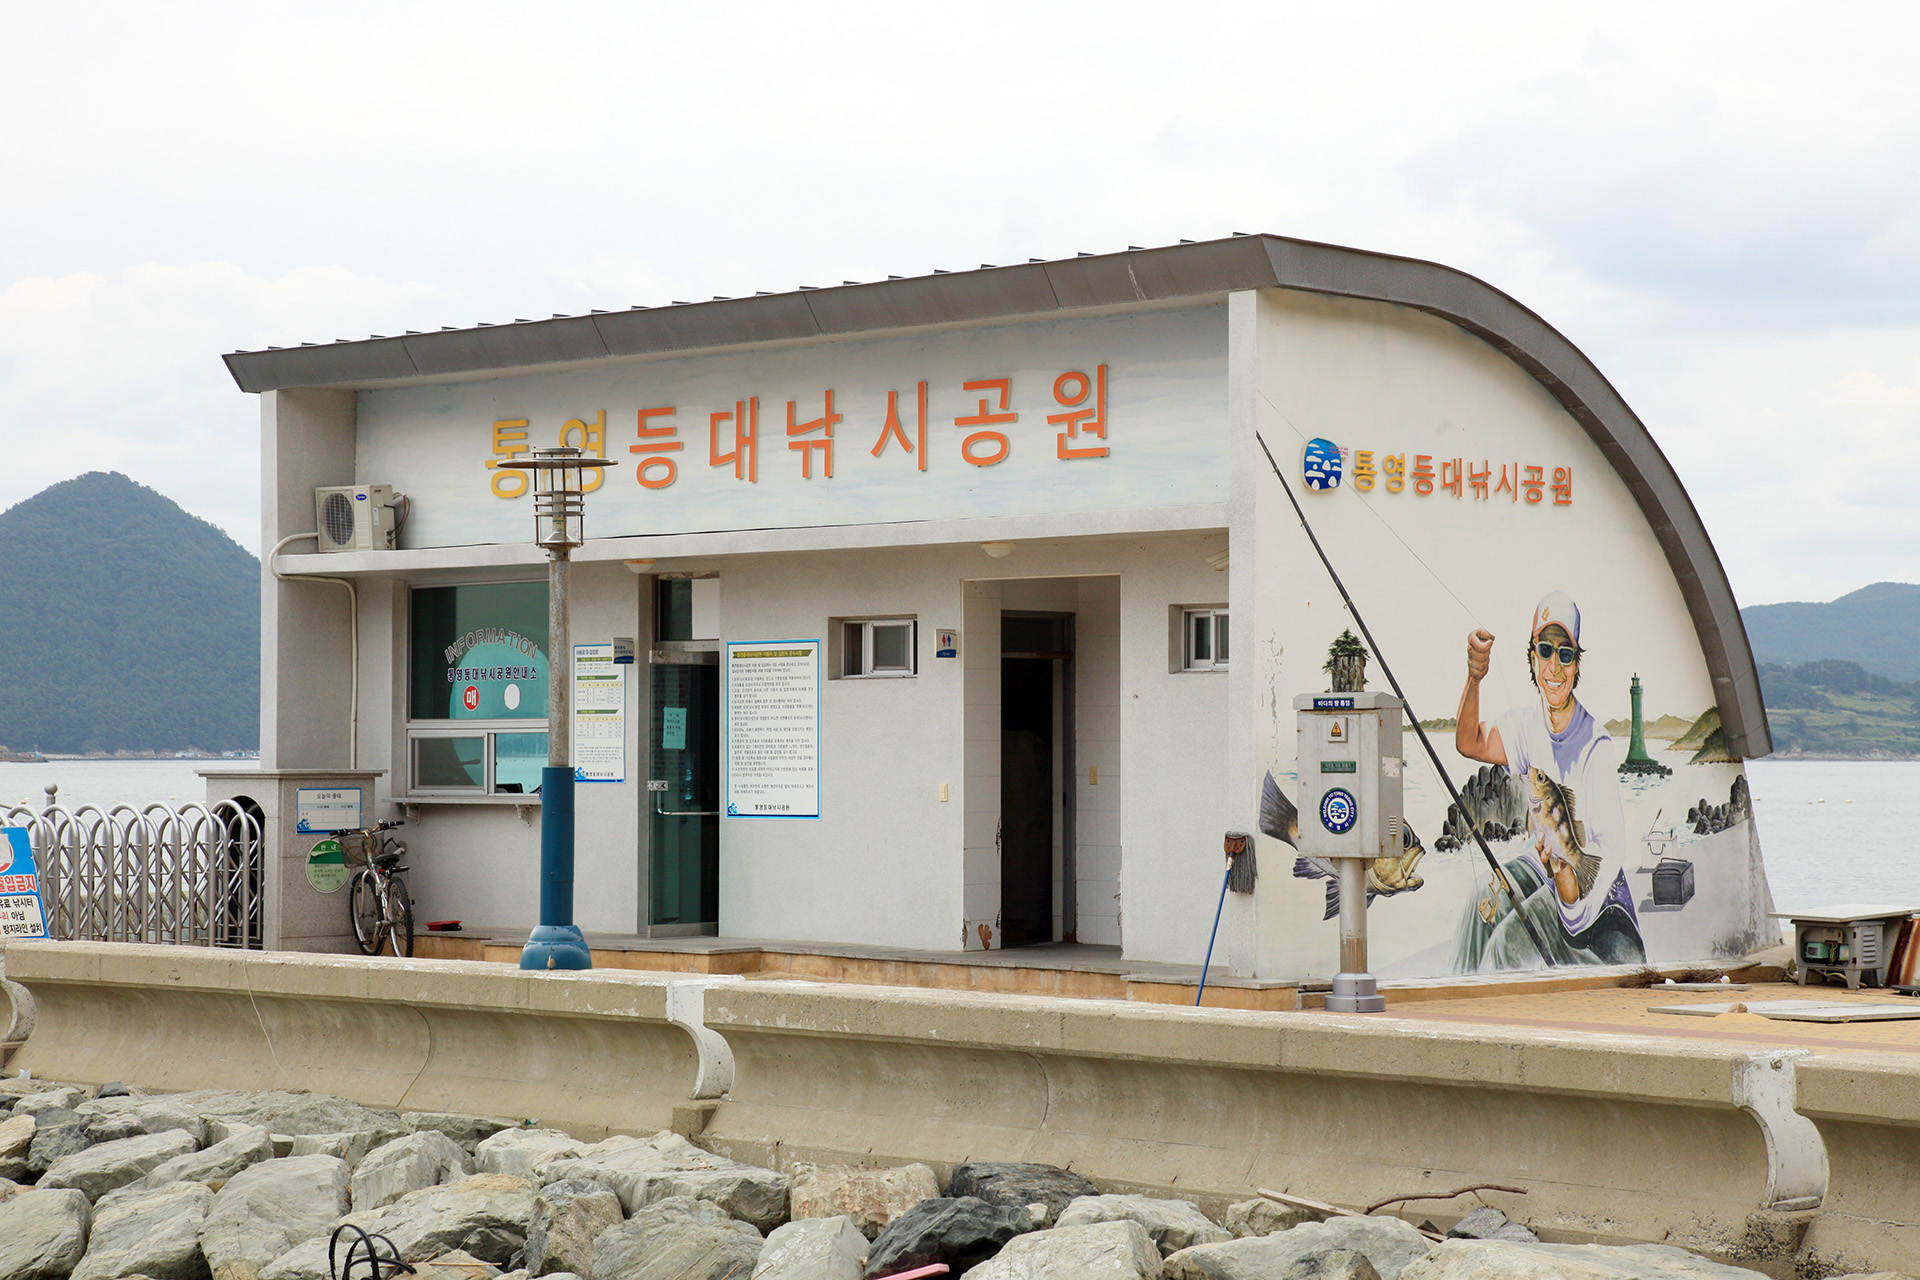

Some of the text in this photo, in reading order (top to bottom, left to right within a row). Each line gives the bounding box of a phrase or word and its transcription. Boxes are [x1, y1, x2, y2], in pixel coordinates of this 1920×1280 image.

[485, 364, 1109, 499] 통영등대낚시공원
[1353, 450, 1573, 506] 통영등대낚시공원
[444, 627, 539, 665] INFORMATION
[447, 665, 538, 683] 통영등대낚시공원안내소
[466, 689, 477, 707] 매
[316, 792, 331, 800] 오늘의
[12, 897, 34, 908] 낚시터
[0, 910, 25, 922] 리 아님
[2, 922, 43, 935] 방지라인 설치
